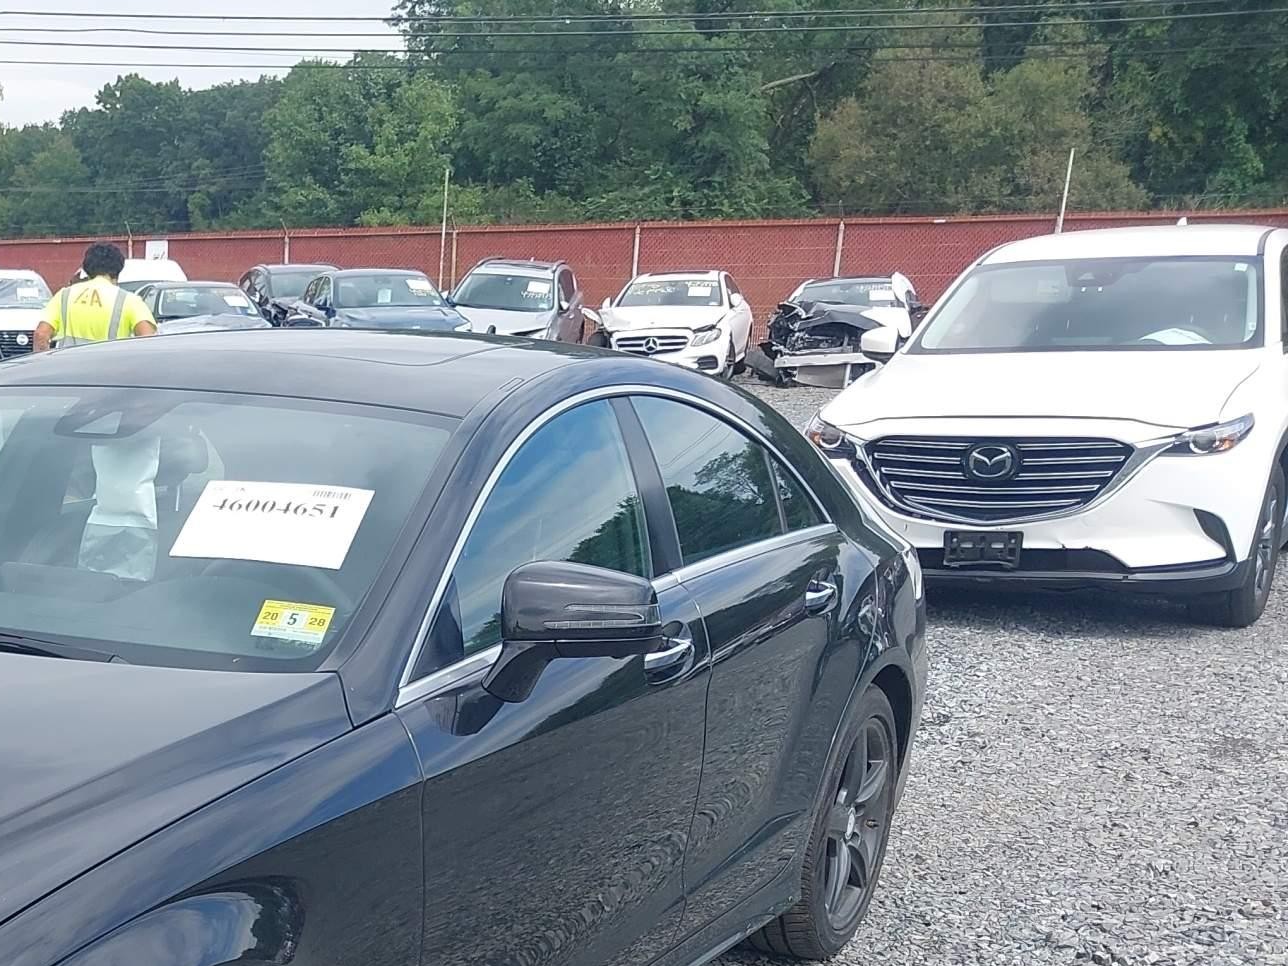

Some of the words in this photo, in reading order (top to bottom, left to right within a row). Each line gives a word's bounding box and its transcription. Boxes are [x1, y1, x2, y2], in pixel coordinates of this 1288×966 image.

[212, 498, 340, 518] 46004651
[262, 611, 279, 621] 20
[287, 613, 299, 626] 5
[308, 617, 326, 627] 28
